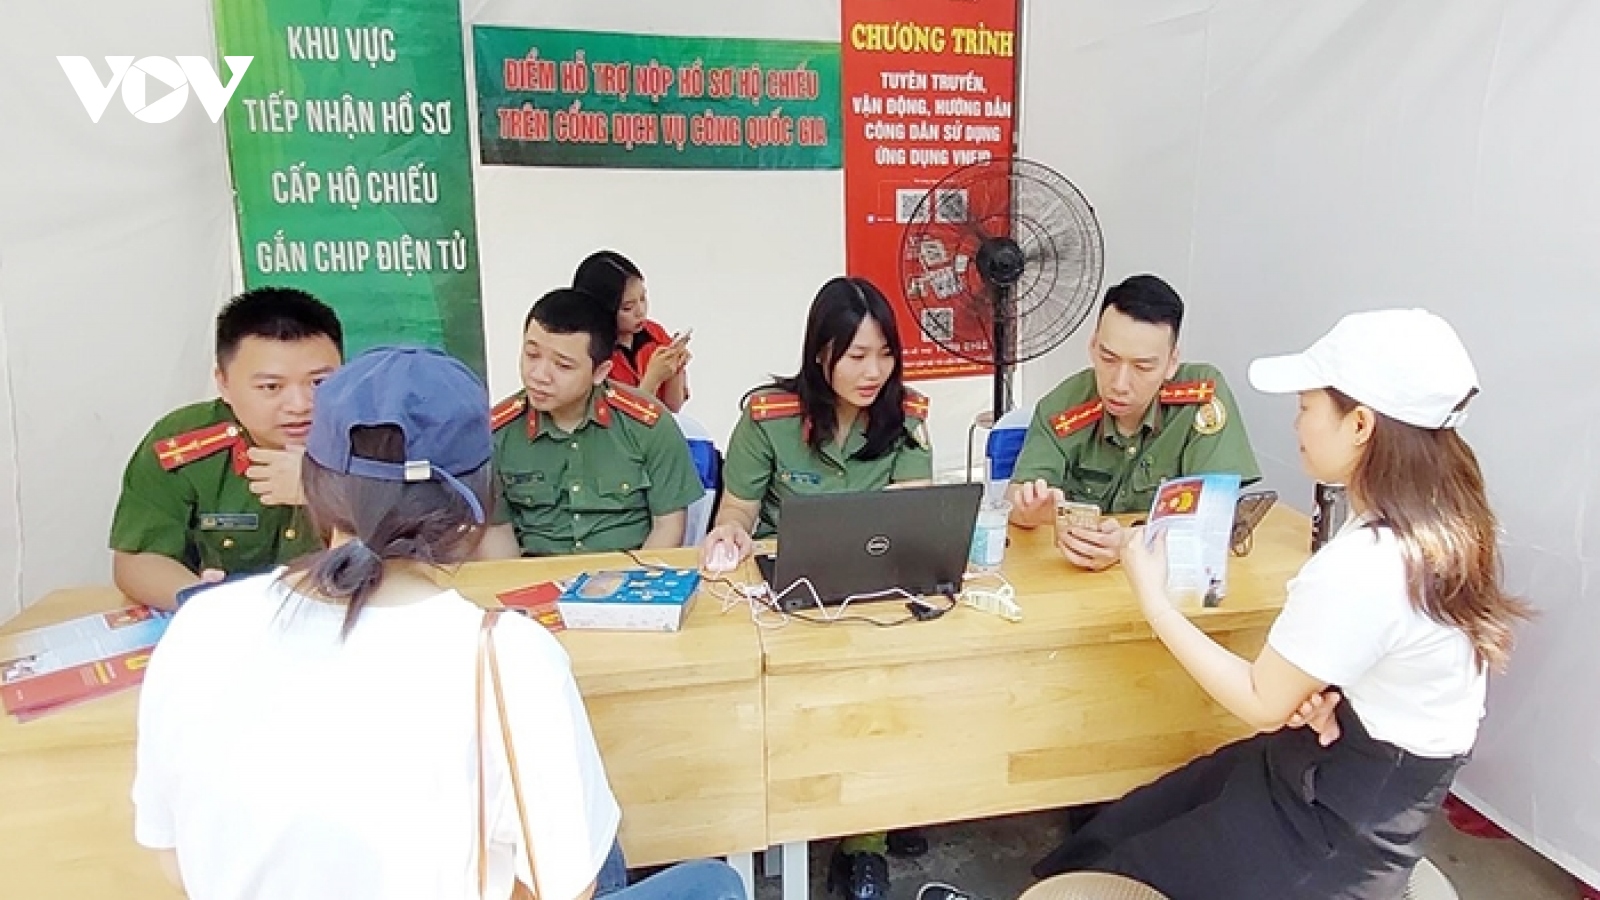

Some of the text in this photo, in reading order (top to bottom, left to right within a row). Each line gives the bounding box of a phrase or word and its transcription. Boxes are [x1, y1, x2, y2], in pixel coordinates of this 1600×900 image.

[287, 26, 396, 69] KHU VỰC
[851, 21, 1014, 57] CHƯƠNG TRÌNH
[592, 61, 631, 102] TRỢ
[633, 58, 675, 102] NỘP
[678, 56, 704, 97] HỒ
[708, 64, 734, 98] SƠ
[737, 61, 763, 107] HỘ
[766, 60, 818, 100] CHIẾU
[880, 70, 927, 90] TUYÊN
[242, 90, 452, 140] TIẾP NHẬN HỒ SƠ
[498, 99, 828, 151] TRÊN CỔNG DỊCH VỤ CÔNG QUỐC GIA
[852, 93, 882, 118] VẬN
[865, 120, 1001, 145] CÔNG DÂN SỬ DỤNG
[910, 149, 949, 168] DỤNG
[272, 161, 438, 210] CẤP HỘ CHIẾU
[256, 229, 307, 273] GẮN
[313, 241, 370, 272] CHIP
[376, 234, 432, 277] ĐIỆN
